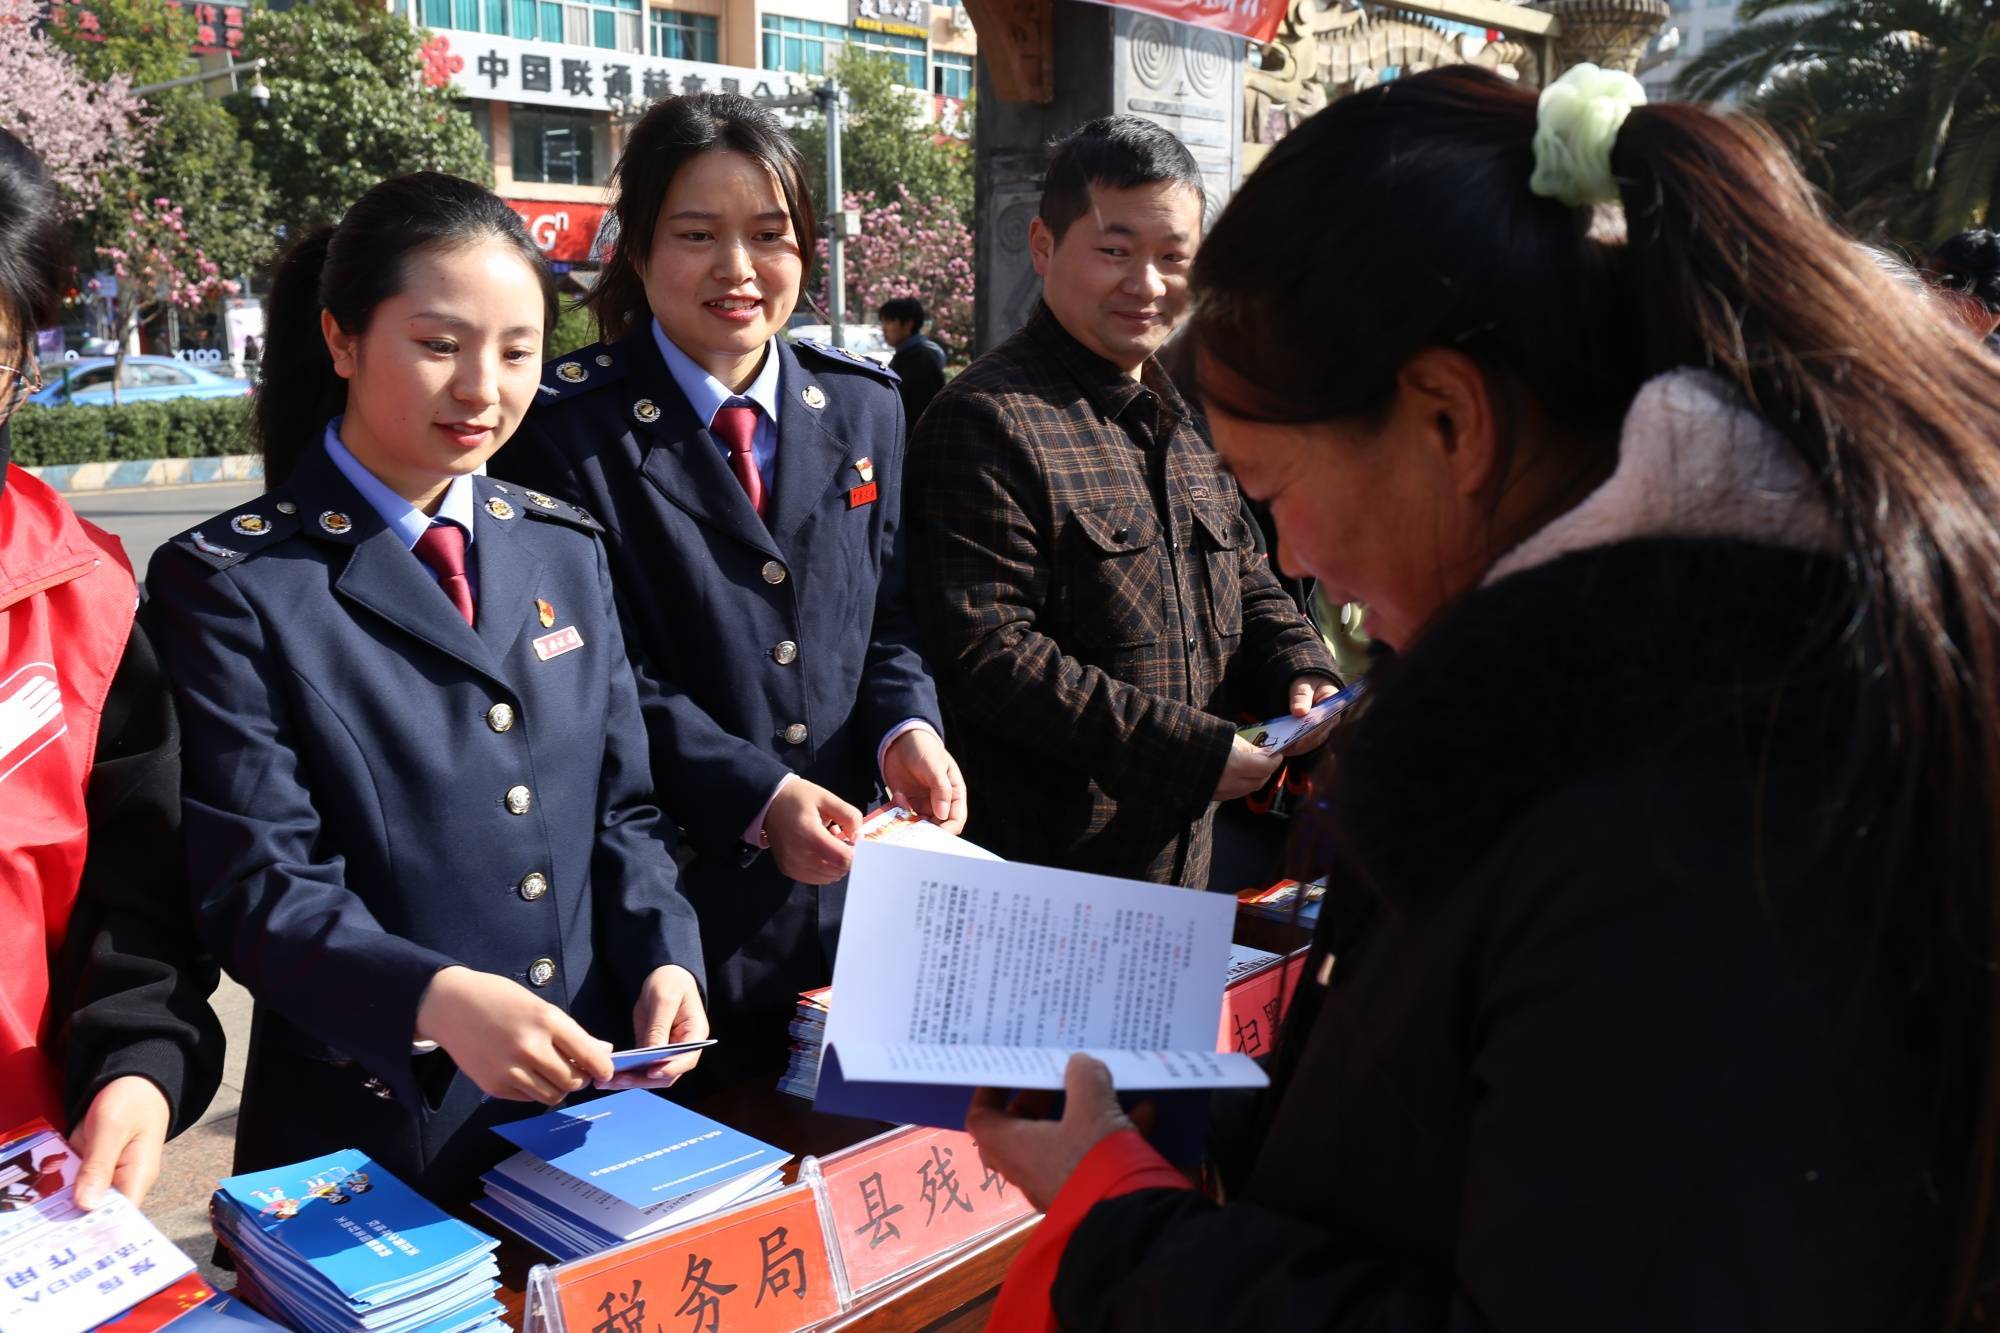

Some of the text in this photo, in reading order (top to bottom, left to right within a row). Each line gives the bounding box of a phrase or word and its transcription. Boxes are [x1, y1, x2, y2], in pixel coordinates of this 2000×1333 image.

[521, 211, 569, 251] Gn
[592, 1226, 807, 1333] 税务局
